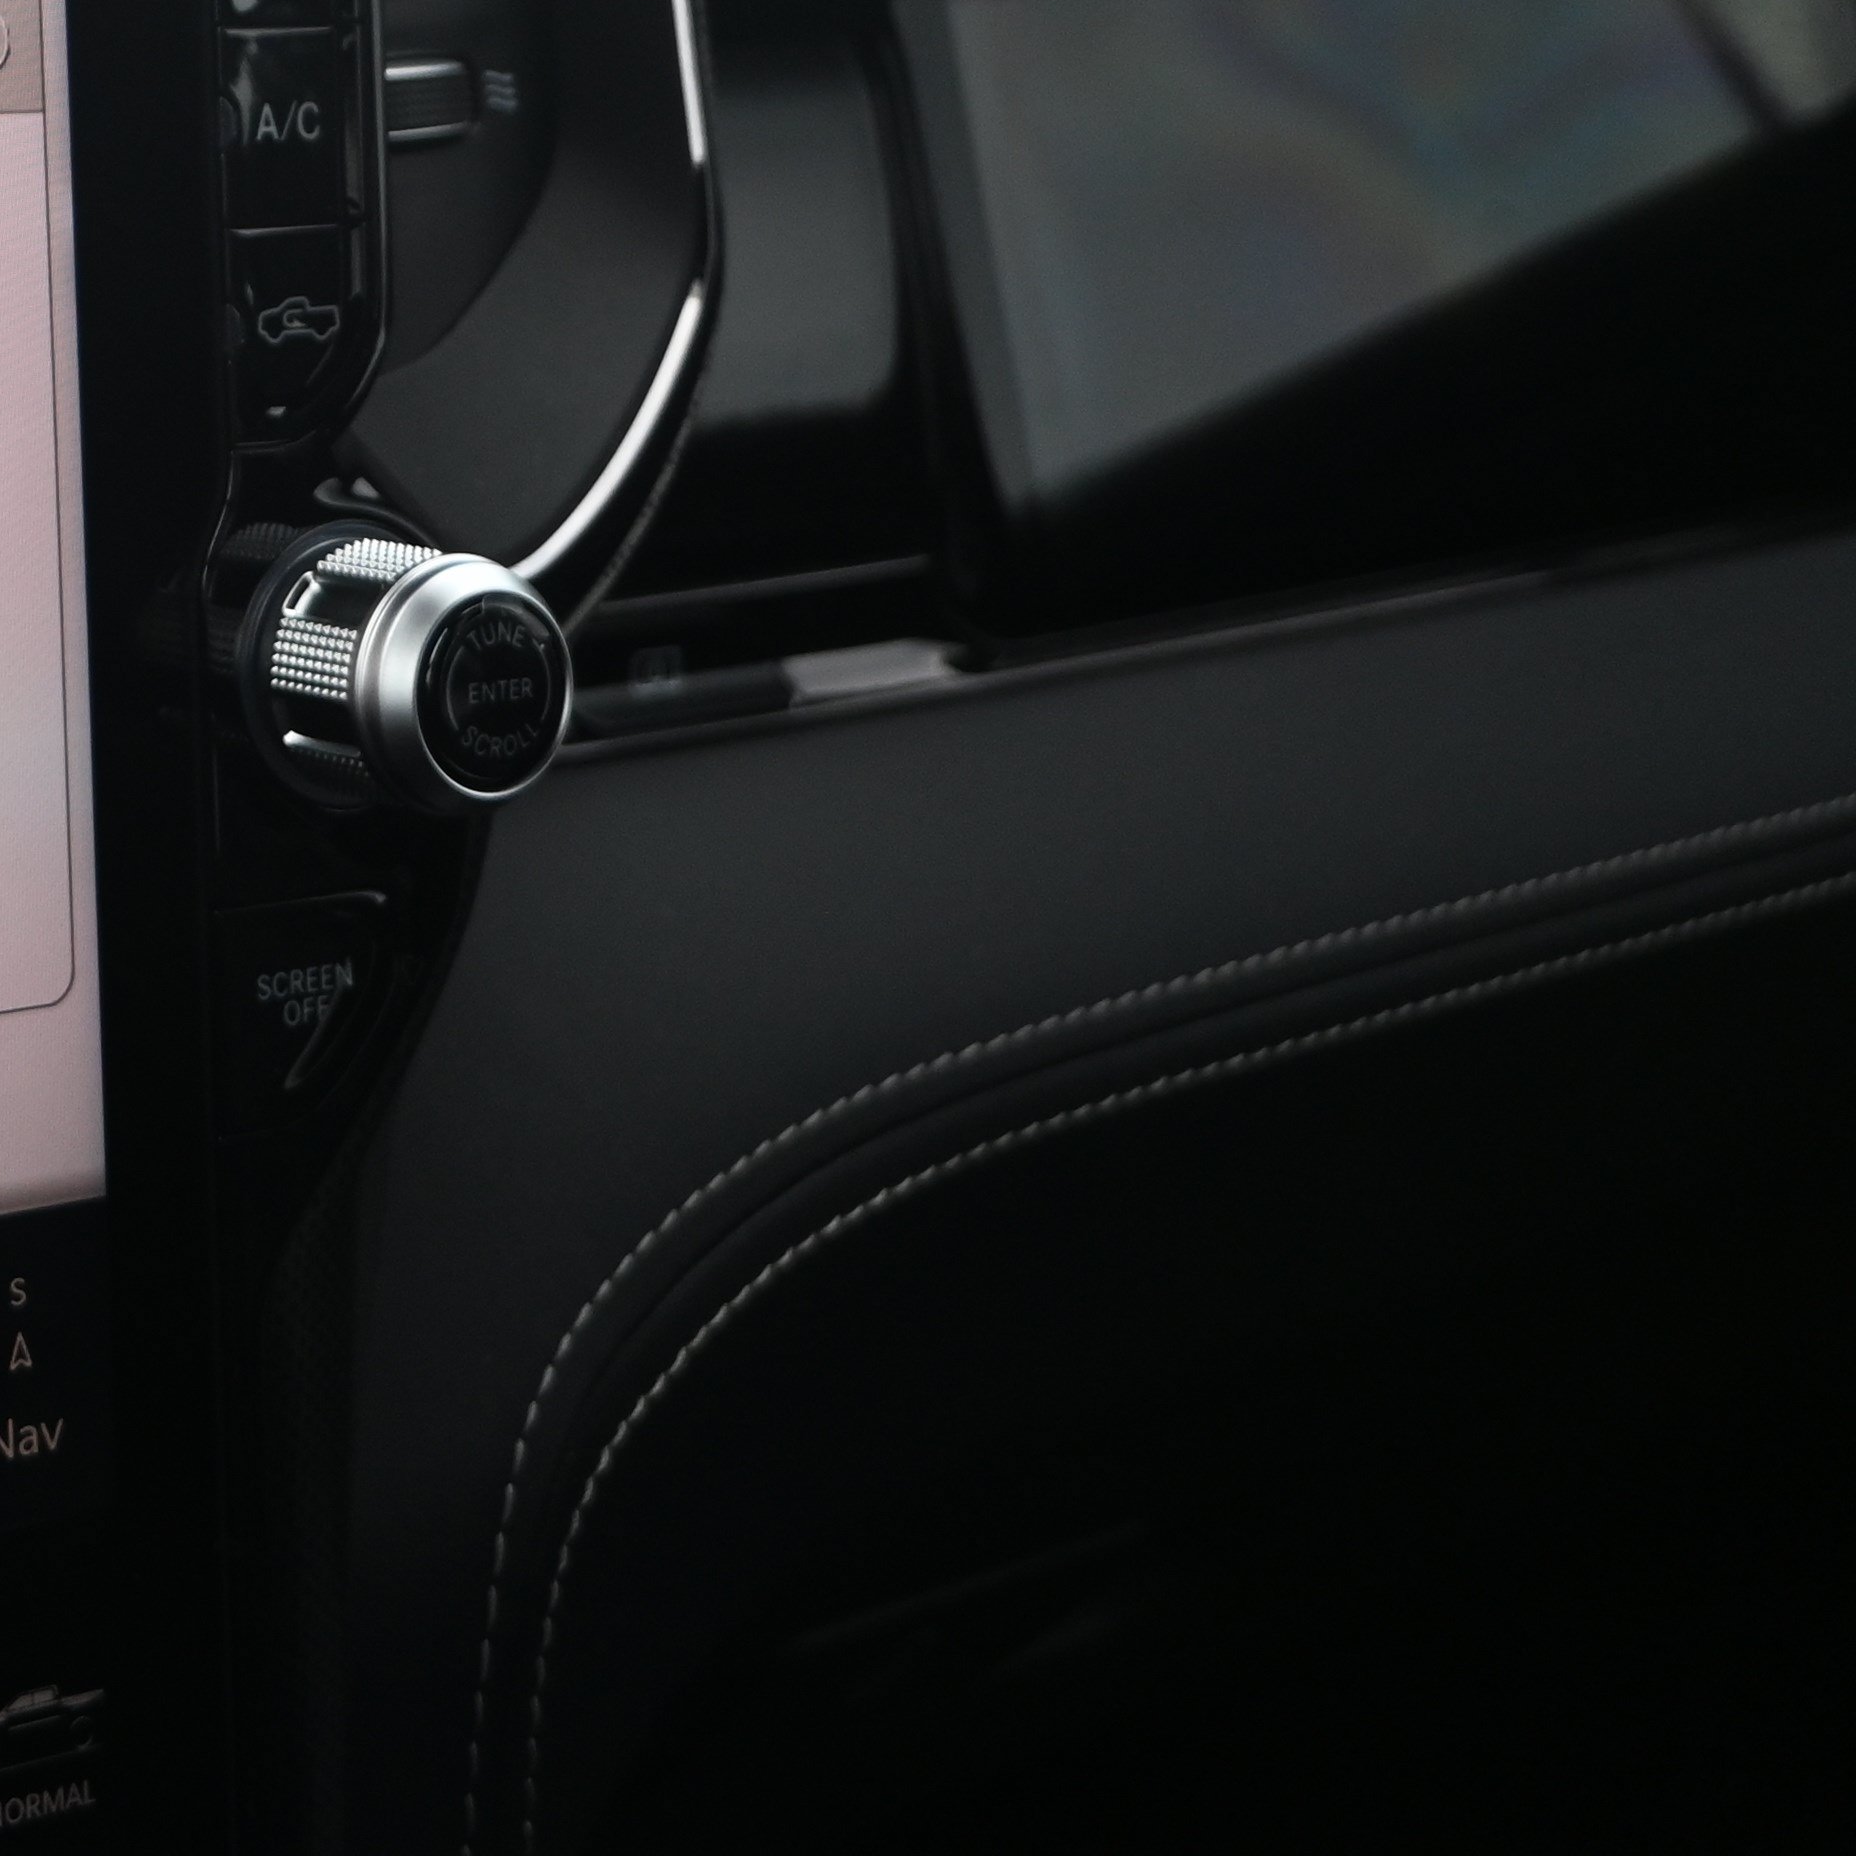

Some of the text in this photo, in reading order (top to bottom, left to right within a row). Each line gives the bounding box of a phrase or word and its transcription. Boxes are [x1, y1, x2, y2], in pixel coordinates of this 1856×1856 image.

[256, 100, 321, 141] A/C
[466, 619, 527, 651] TUNE
[467, 676, 534, 704] ENTER
[461, 722, 540, 758] SCROLL
[256, 956, 354, 1001] SCREEN
[282, 994, 331, 1027] OFF
[10, 1276, 27, 1306] S
